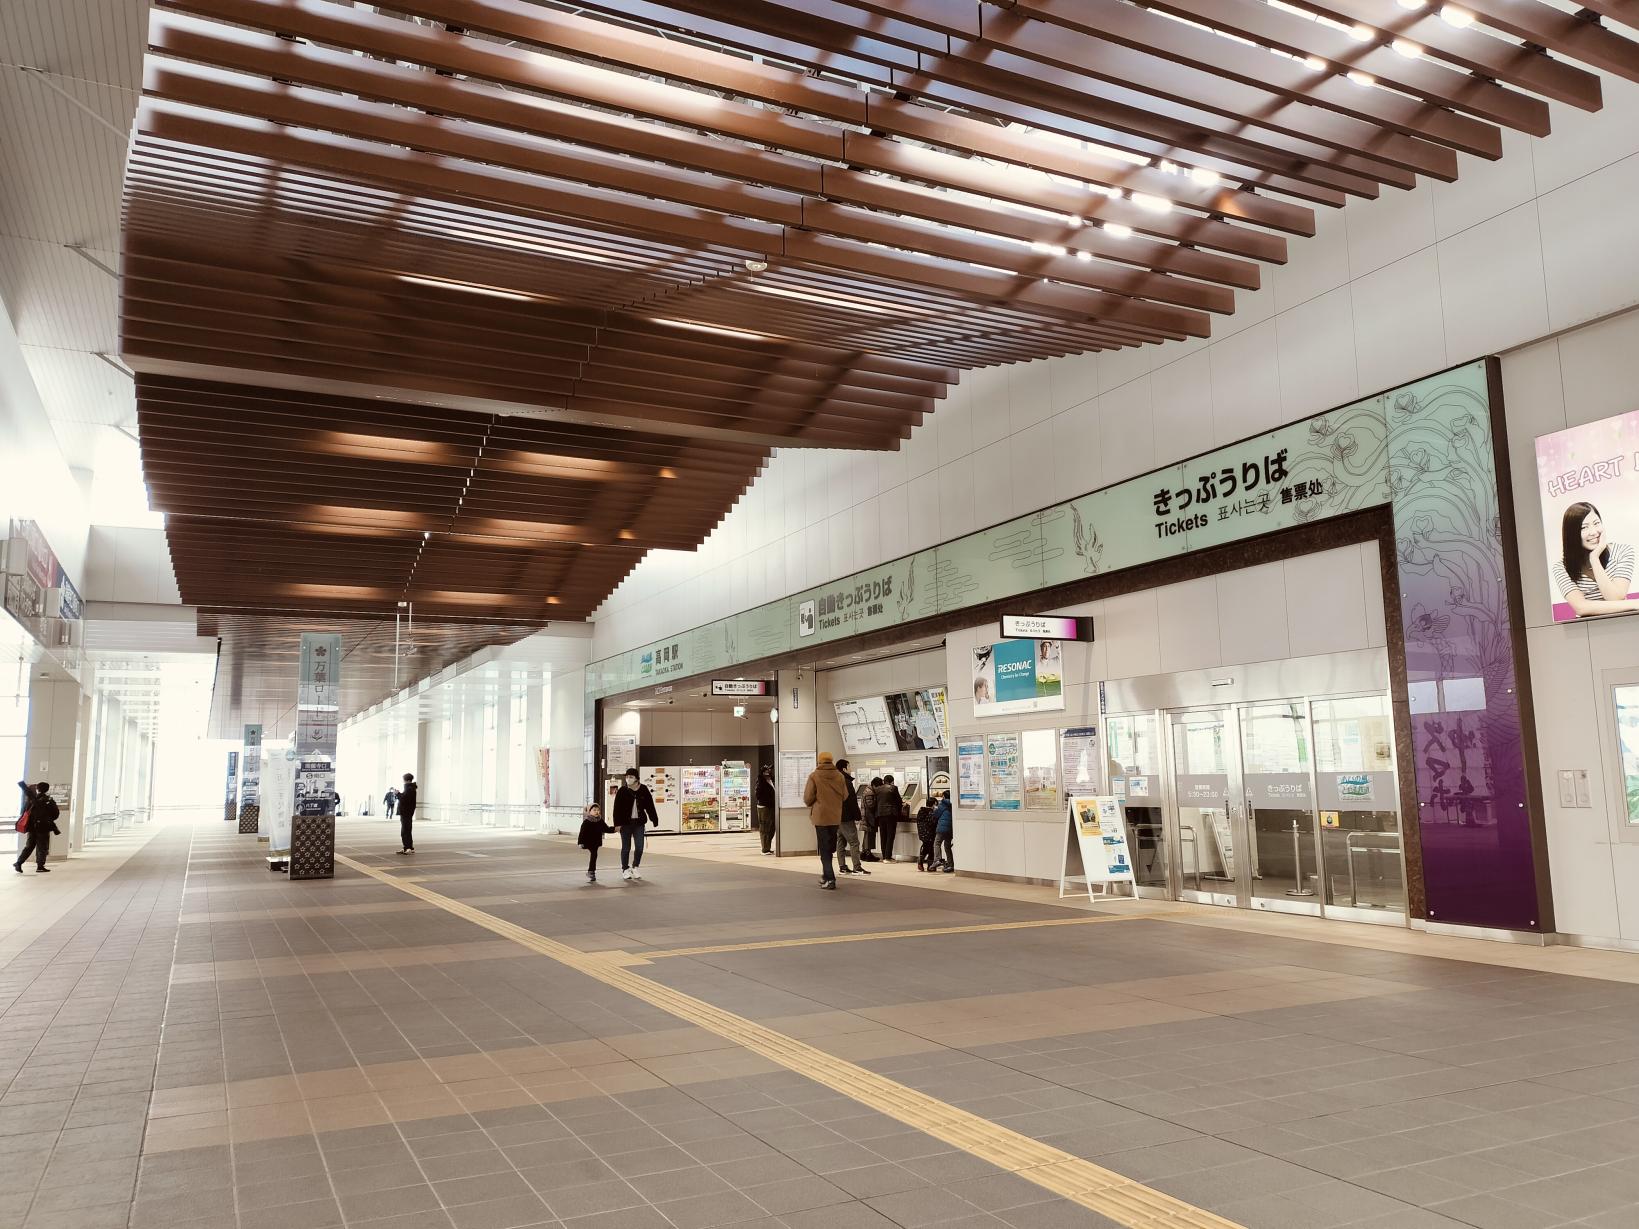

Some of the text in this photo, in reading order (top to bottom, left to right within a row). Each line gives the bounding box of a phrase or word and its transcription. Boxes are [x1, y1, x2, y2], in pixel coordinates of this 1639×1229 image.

[1153, 448, 1289, 517] きっぷうりば
[1548, 455, 1624, 497] HEART
[1279, 478, 1323, 505] 售票处
[1155, 513, 1208, 538] Tickets
[819, 616, 841, 630] Tickets
[997, 660, 1032, 674] RESONAC
